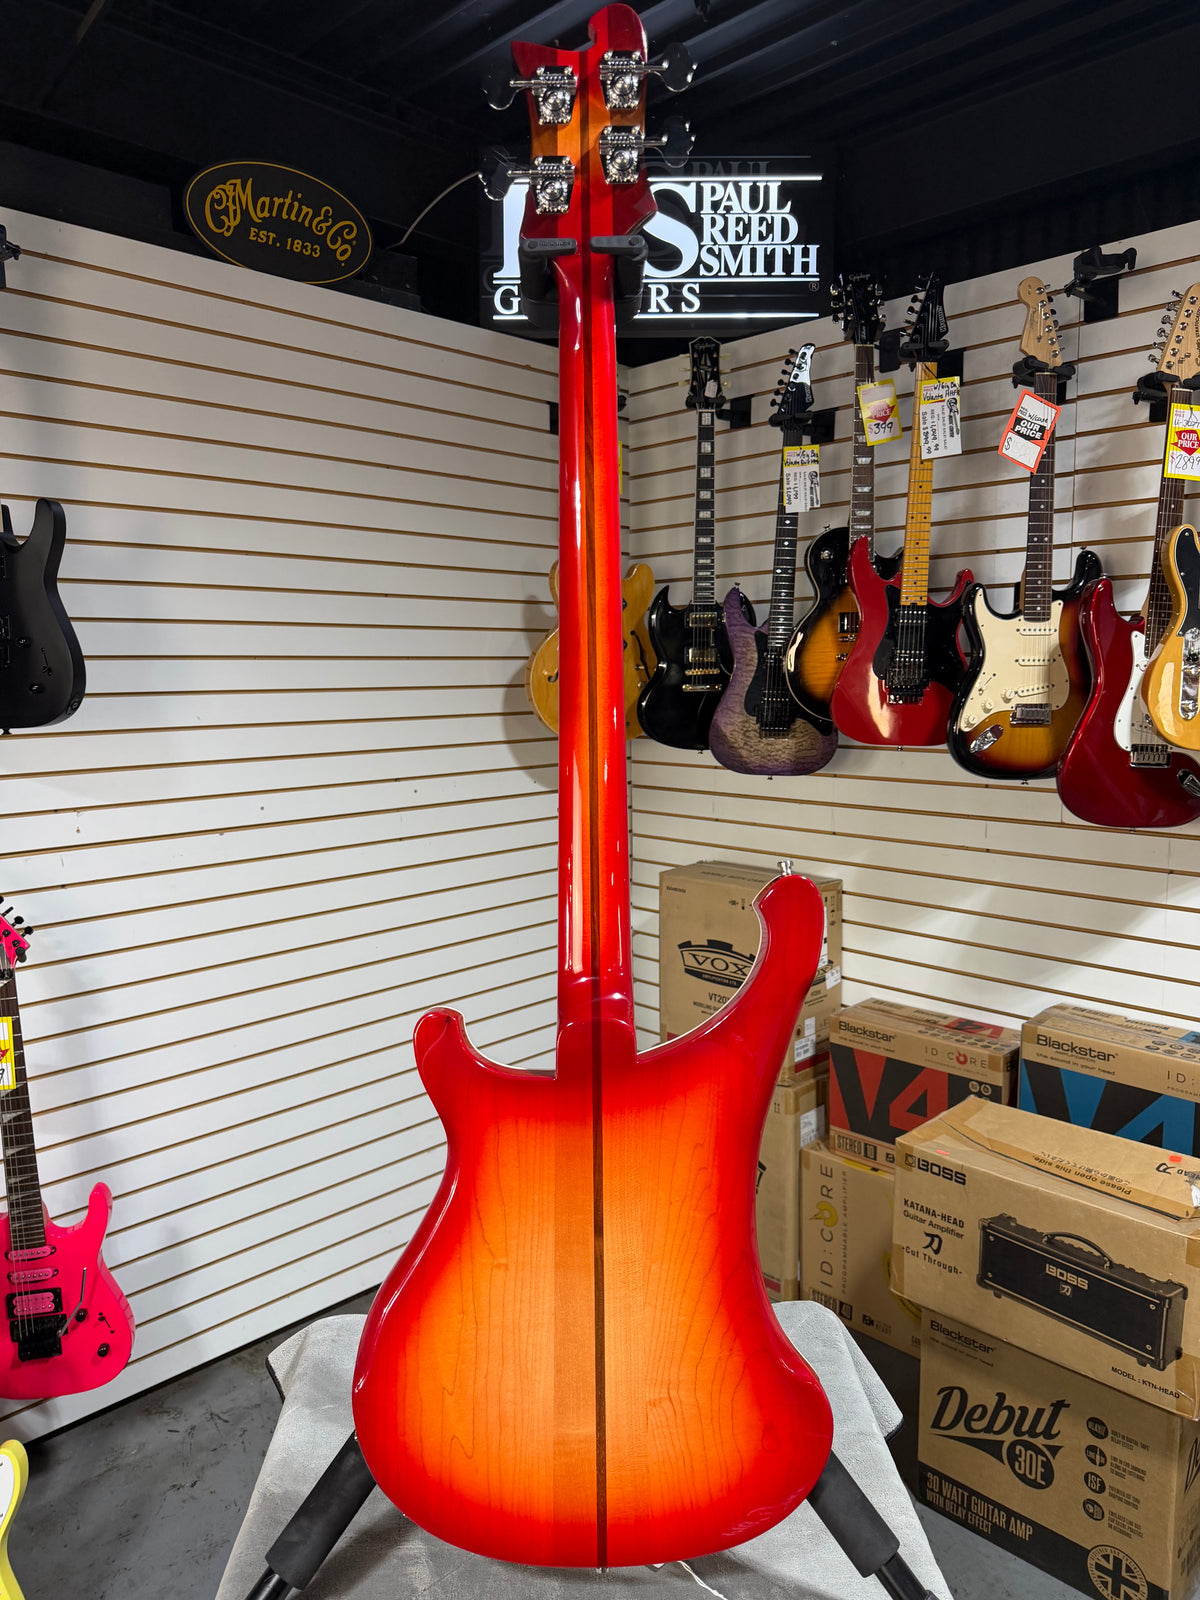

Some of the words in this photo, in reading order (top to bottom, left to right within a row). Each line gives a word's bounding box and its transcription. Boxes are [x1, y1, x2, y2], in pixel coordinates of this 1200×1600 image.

[700, 182, 792, 214] PAUL
[249, 227, 280, 247] EST.
[286, 237, 321, 258] 1833
[700, 214, 799, 245] REED
[700, 245, 820, 277] SMITH
[1014, 425, 1043, 440] PRICE
[1020, 419, 1041, 432] OUR
[1181, 432, 1198, 441] OUR
[1177, 439, 1200, 449] PRICE
[688, 952, 751, 977] VOX
[838, 1020, 896, 1043] Blackstar
[1036, 1033, 1117, 1063] Blackstar
[836, 1134, 862, 1156] STEREO
[917, 1157, 967, 1186] BOSS
[1055, 1164, 1072, 1174] this
[1074, 1170, 1098, 1183] open
[1099, 1179, 1132, 1196] Please
[903, 1197, 965, 1229] KATANA-HEAD
[903, 1209, 926, 1225] Guitar
[928, 1220, 965, 1240] Amplifier
[1045, 1263, 1089, 1290] BOSS
[930, 1319, 995, 1354] Blackstar
[1111, 1366, 1137, 1382] MODEL
[1142, 1379, 1180, 1399] KTN-HEAD
[930, 1385, 1071, 1440] Debut
[1014, 1444, 1047, 1486] 30E
[1087, 1473, 1102, 1494] ISF
[926, 1472, 940, 1493] 30
[942, 1479, 969, 1508] WATT
[971, 1496, 1007, 1530] GUITAR
[1008, 1516, 1033, 1541] AMP
[926, 1489, 944, 1508] WITH
[945, 1500, 967, 1521] DELAY
[967, 1511, 993, 1535] EFFECT
